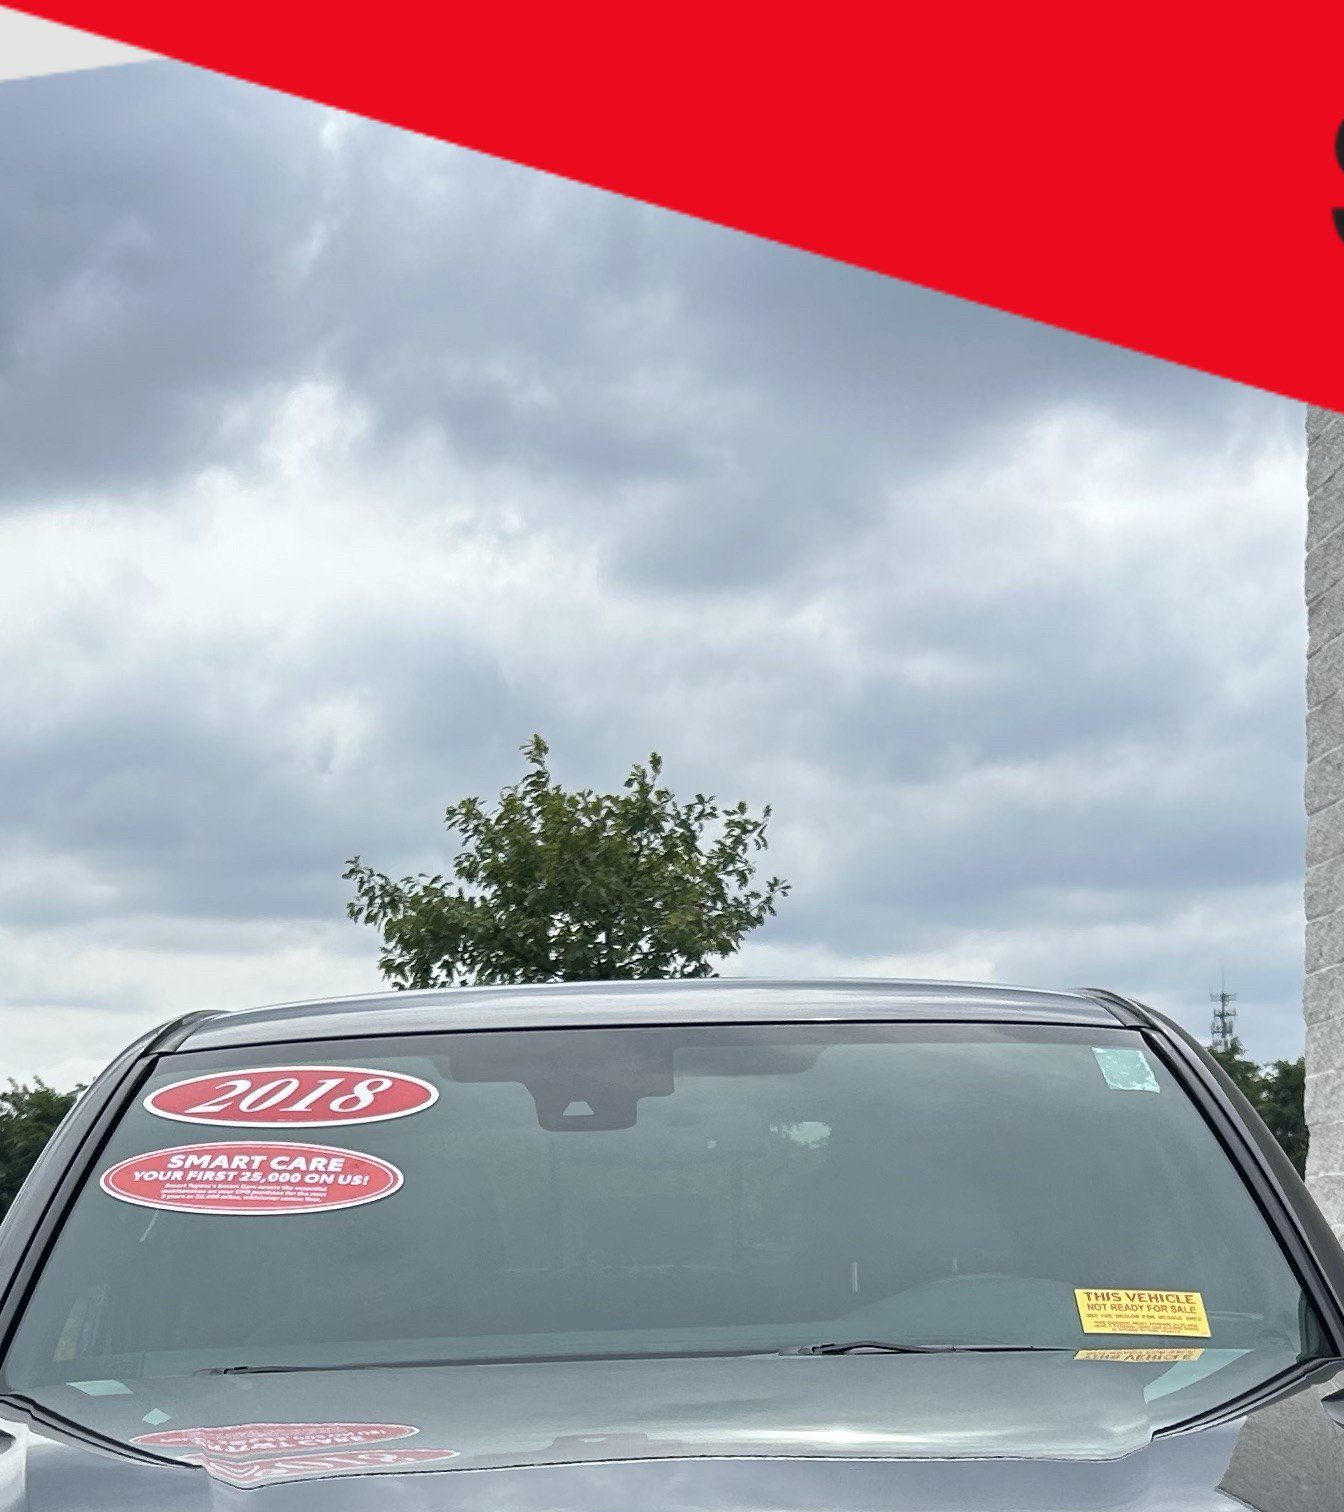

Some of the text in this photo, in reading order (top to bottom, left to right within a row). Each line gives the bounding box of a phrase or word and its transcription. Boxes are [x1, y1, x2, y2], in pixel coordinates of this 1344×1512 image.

[185, 1075, 394, 1115] 2018
[167, 1153, 346, 1173] SMART CARE
[133, 1170, 370, 1186] YOUR FIRST 25,000 ON US!
[1083, 1291, 1197, 1305] THIS VEHICLE
[1087, 1303, 1197, 1314] NOT READY FOR SALE
